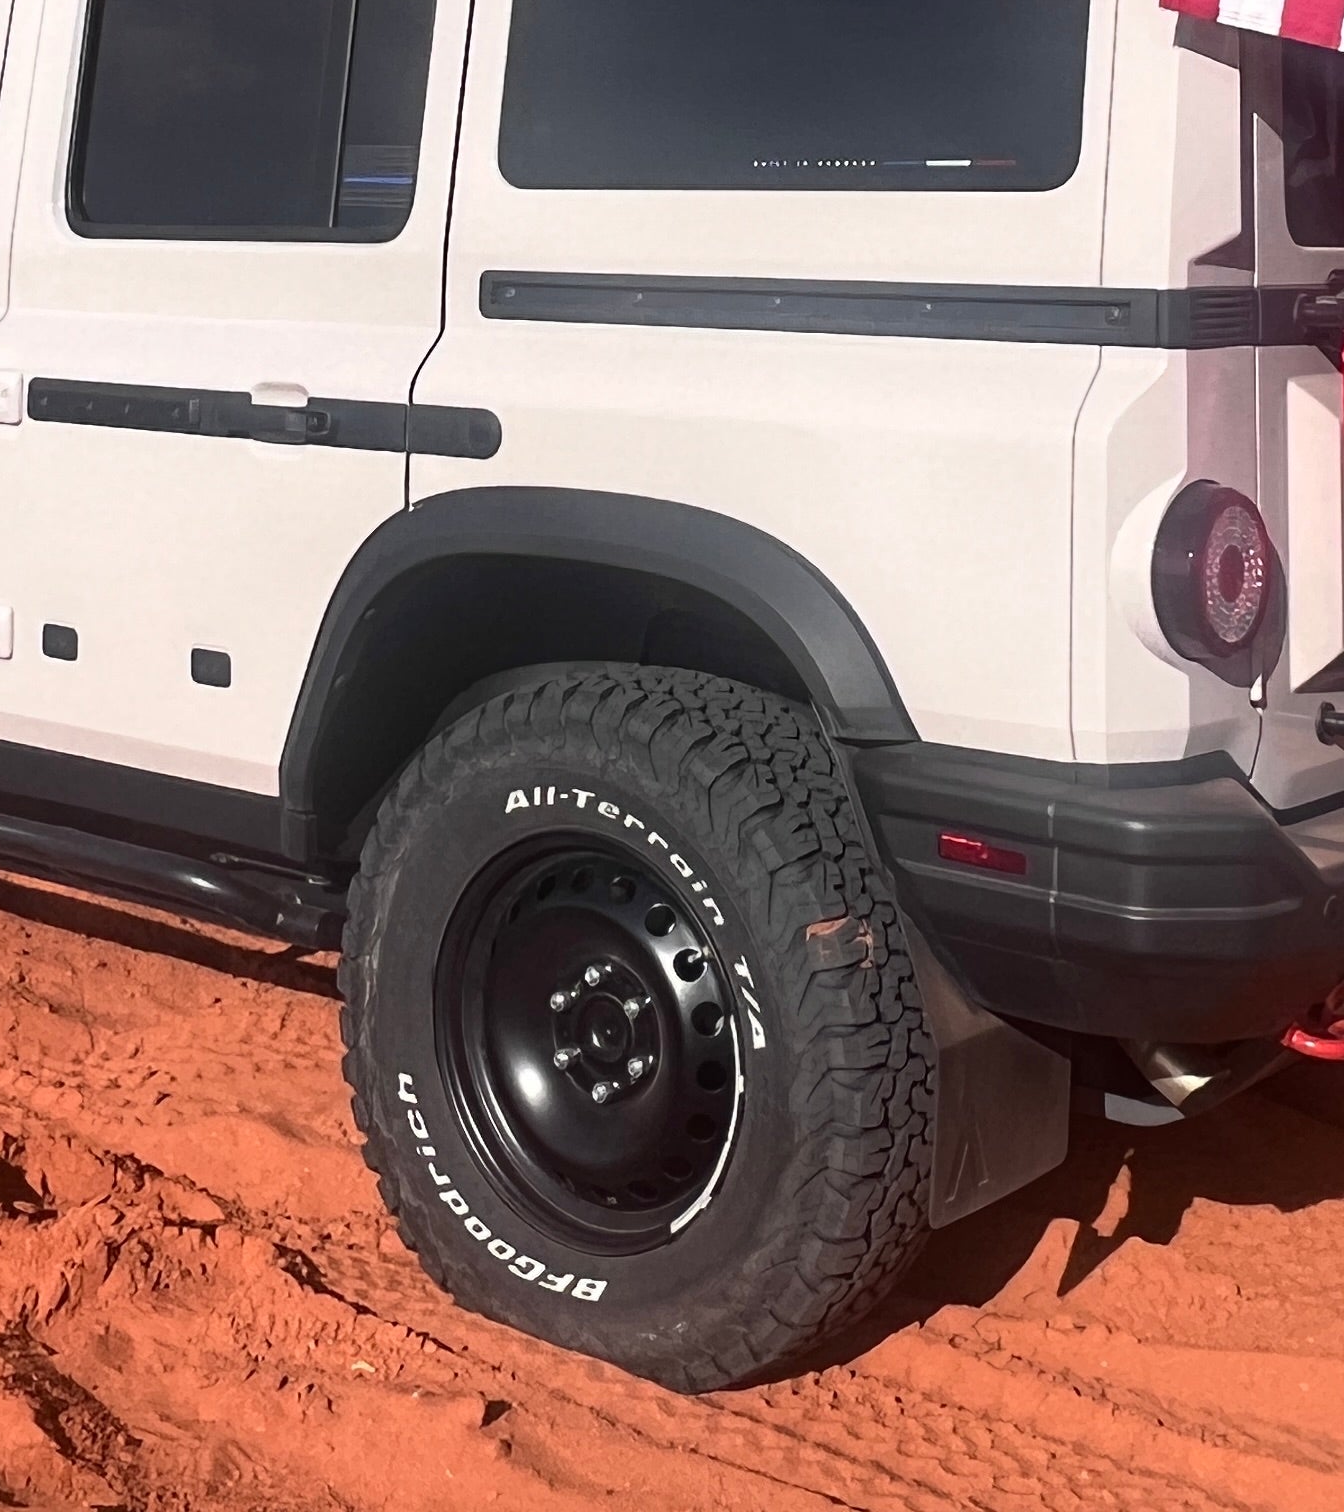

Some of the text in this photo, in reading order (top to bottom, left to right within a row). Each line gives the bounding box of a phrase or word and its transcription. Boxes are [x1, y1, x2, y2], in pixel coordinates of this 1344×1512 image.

[505, 786, 766, 1049] All-Terrain T/A
[397, 1072, 608, 1302] BFGoodrich
